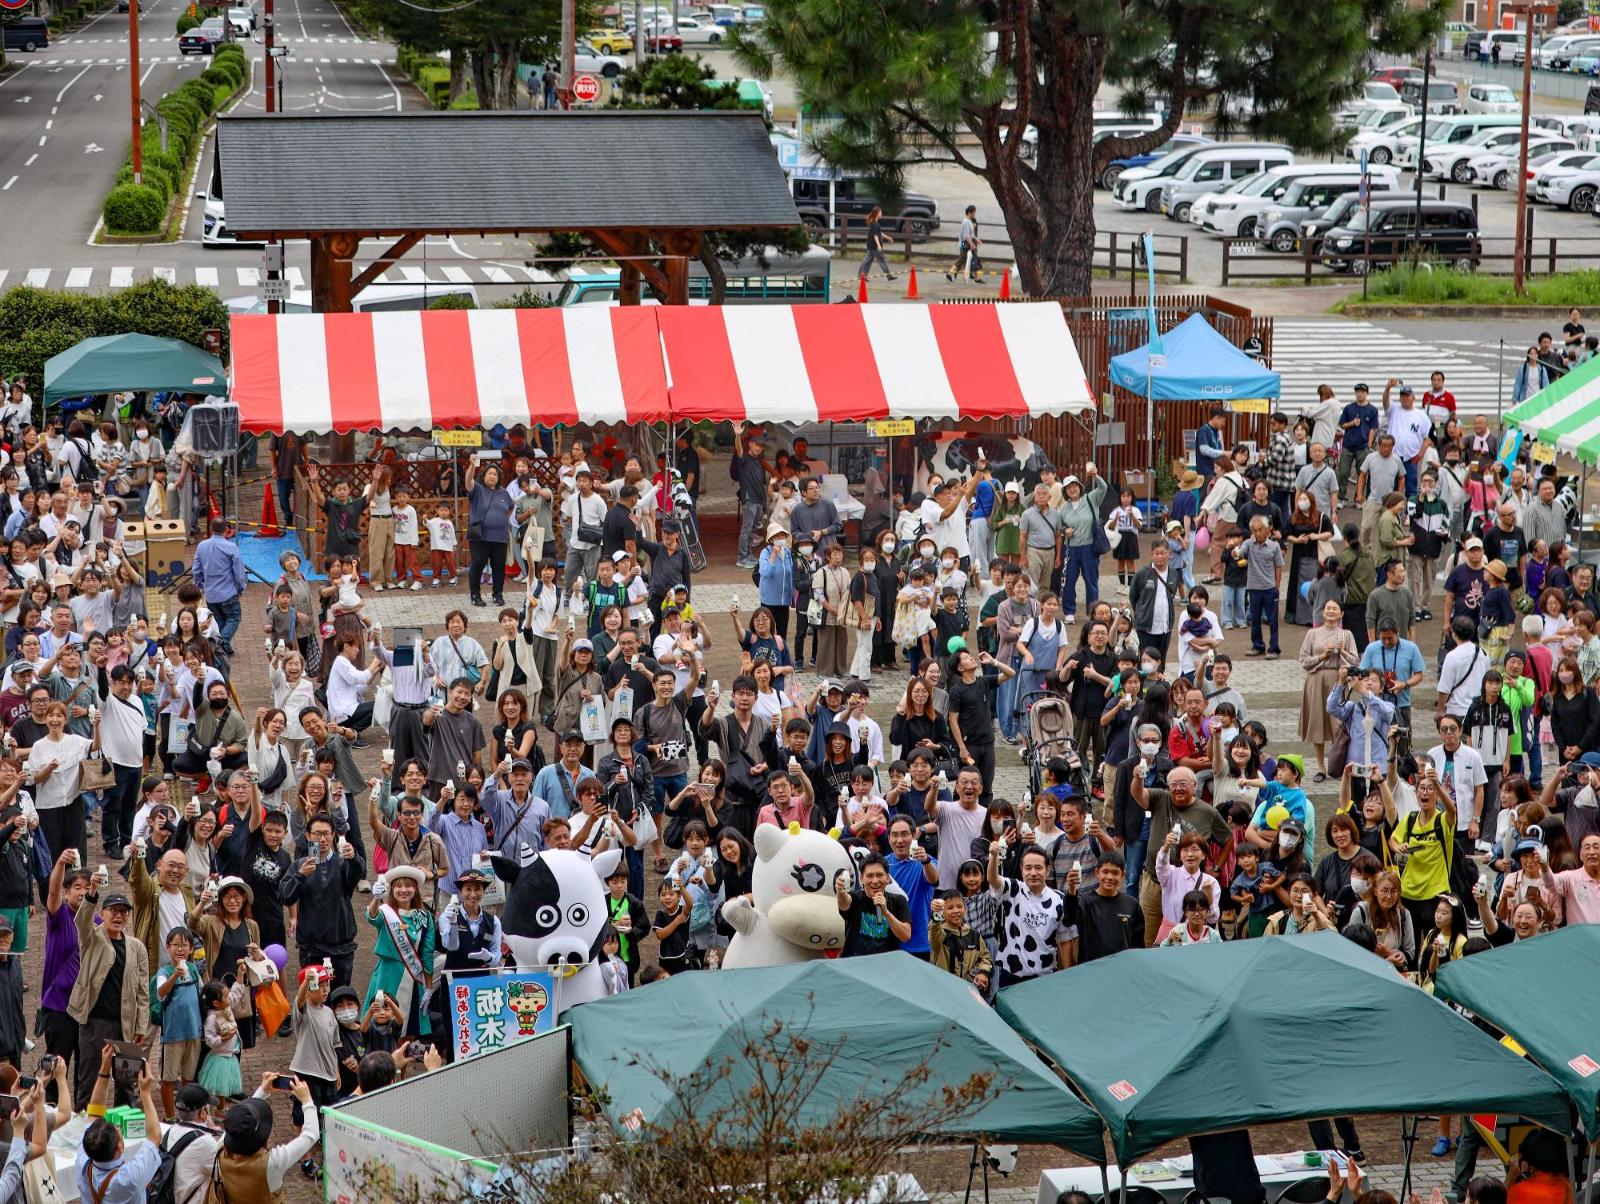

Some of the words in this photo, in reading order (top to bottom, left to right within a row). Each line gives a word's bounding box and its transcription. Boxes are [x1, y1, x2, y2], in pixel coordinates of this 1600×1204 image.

[1231, 247, 1253, 255] 出入口
[1201, 385, 1233, 394] IQOS
